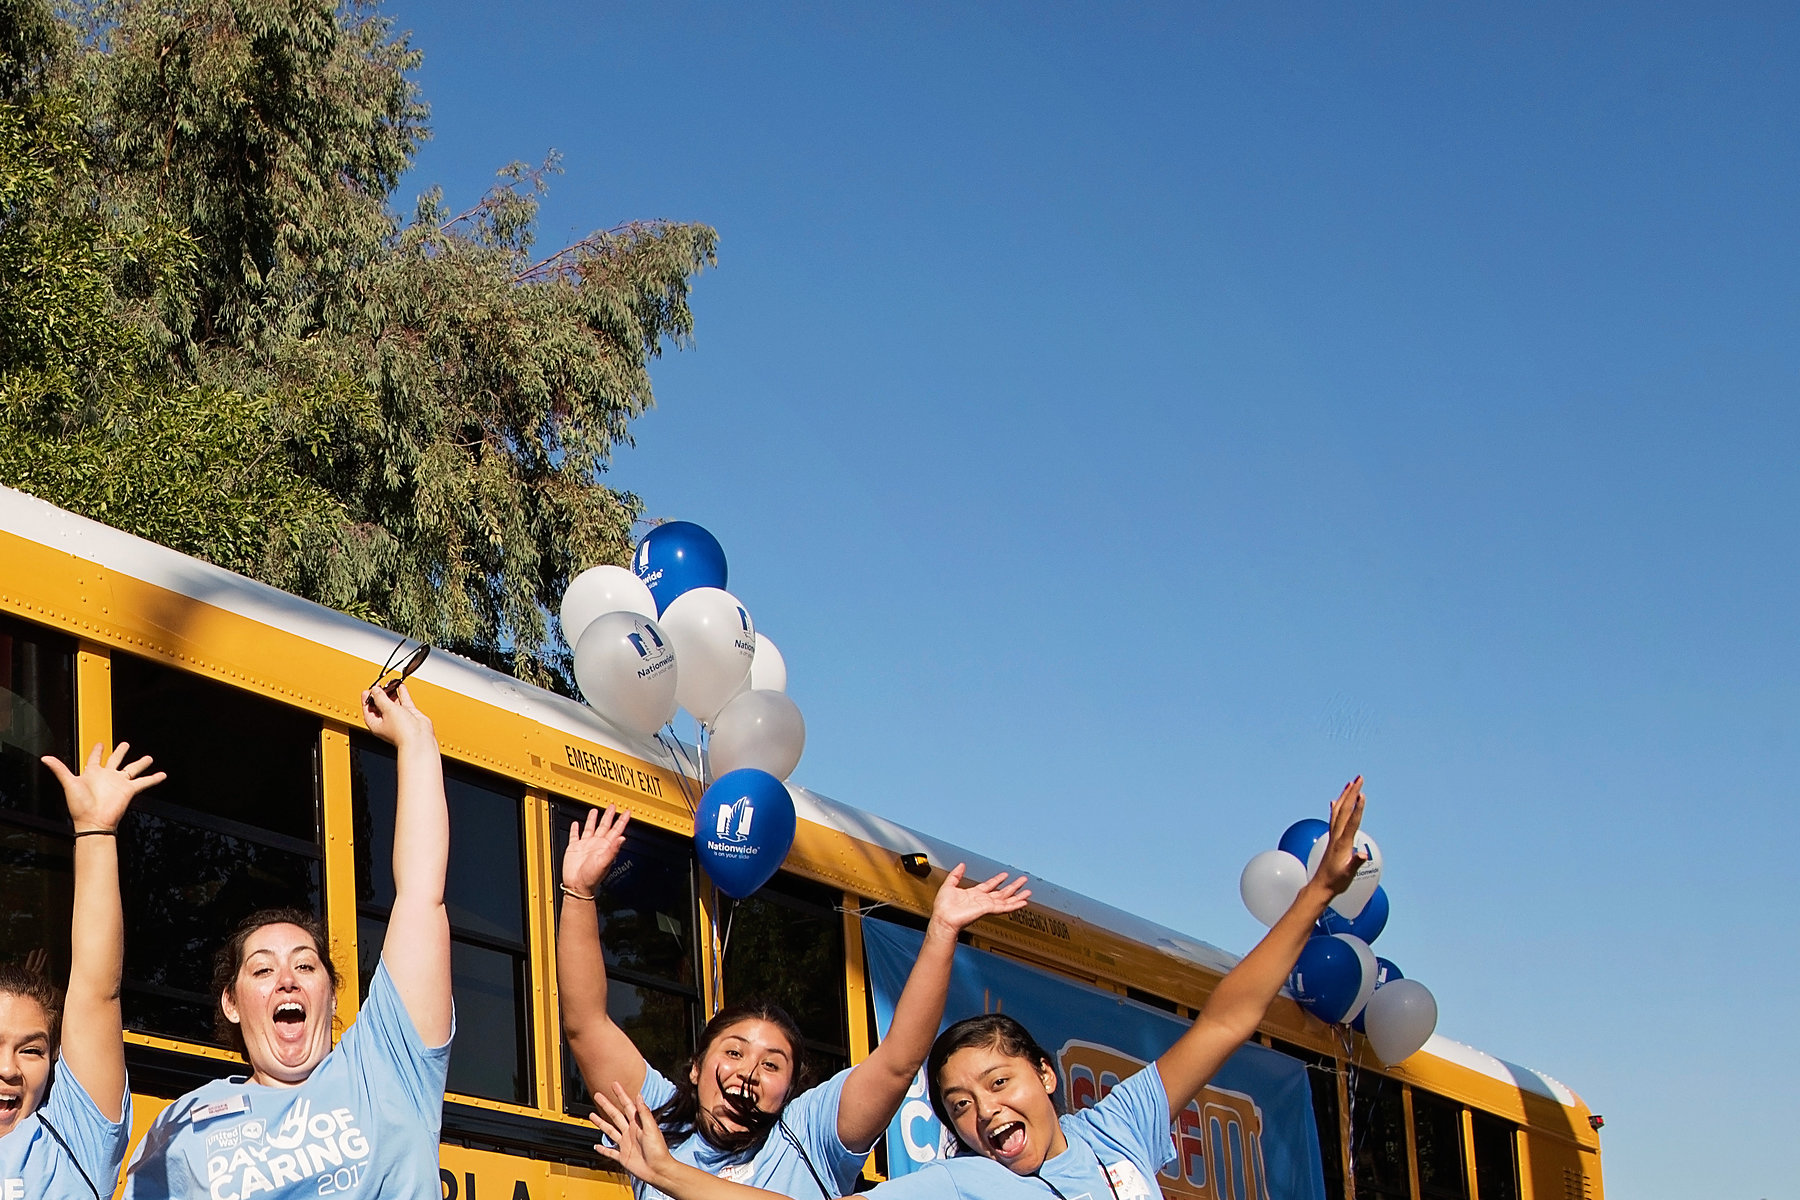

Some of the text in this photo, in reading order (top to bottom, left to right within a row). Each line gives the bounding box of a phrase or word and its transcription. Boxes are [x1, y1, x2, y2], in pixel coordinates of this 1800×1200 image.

[565, 745, 662, 798] EMERGENCY EXIT
[707, 840, 758, 854] Nationwide
[207, 1108, 354, 1182] DAY OF
